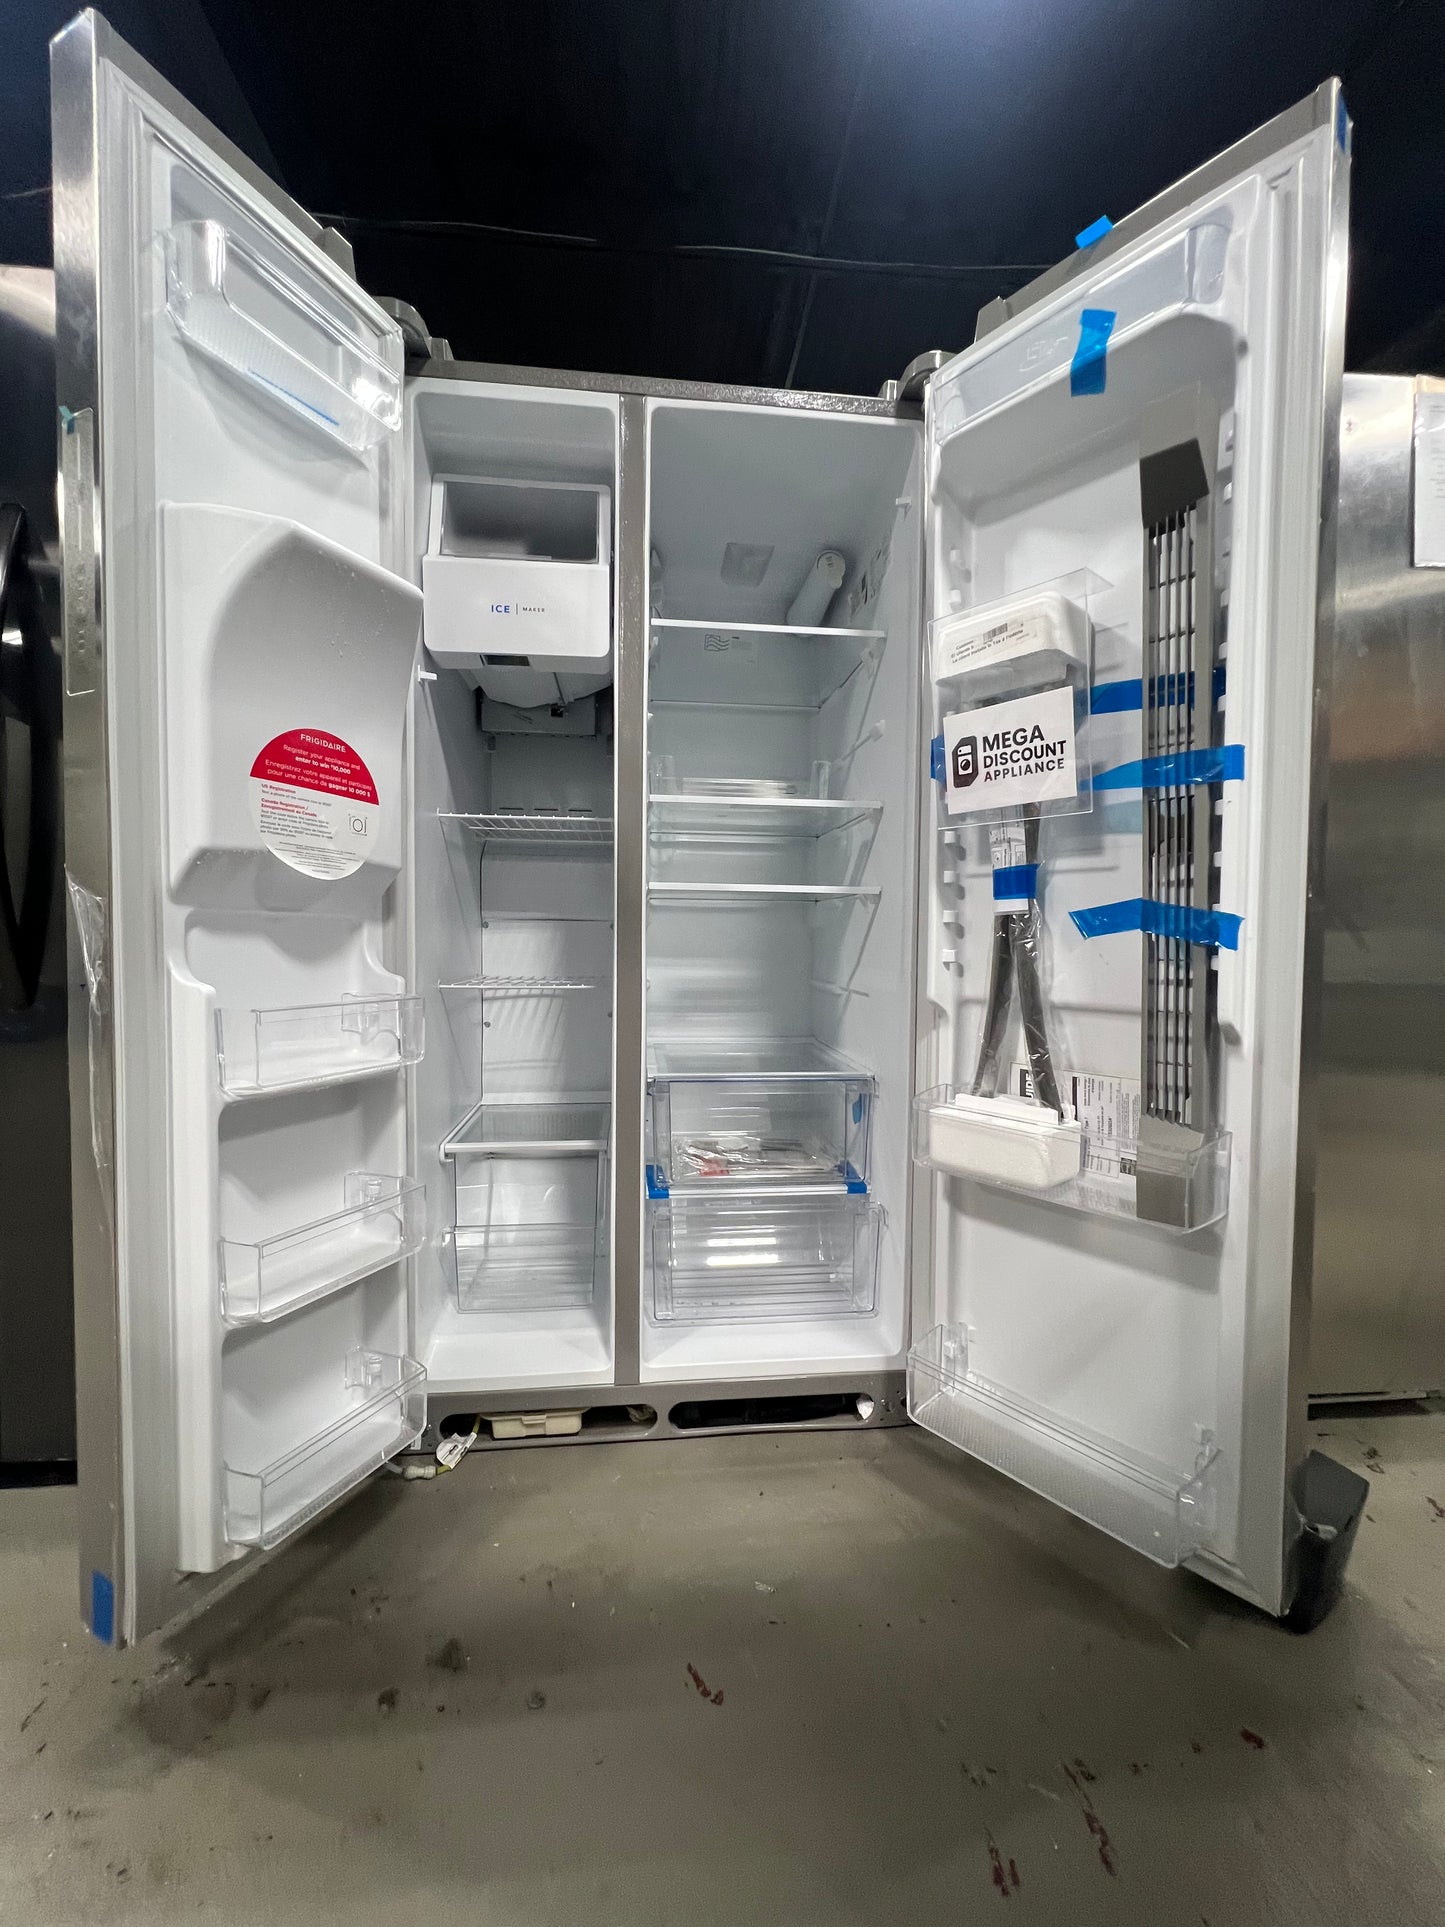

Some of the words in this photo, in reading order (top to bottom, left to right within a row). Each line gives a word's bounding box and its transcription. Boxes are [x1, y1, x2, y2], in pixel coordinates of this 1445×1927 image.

[492, 604, 510, 613] ICE
[300, 734, 346, 753] FRIGIDAIRE
[982, 724, 1045, 752] MEGA
[265, 759, 301, 773] Enregistrez
[283, 744, 309, 756] Register
[324, 756, 351, 768] appliance
[295, 756, 312, 764] enter
[984, 740, 1066, 768] DISCOUNT
[267, 768, 283, 776] pour
[284, 772, 296, 780] une
[297, 774, 318, 785] chance
[328, 782, 348, 792] gagner
[984, 758, 1064, 782] APPLIANCE
